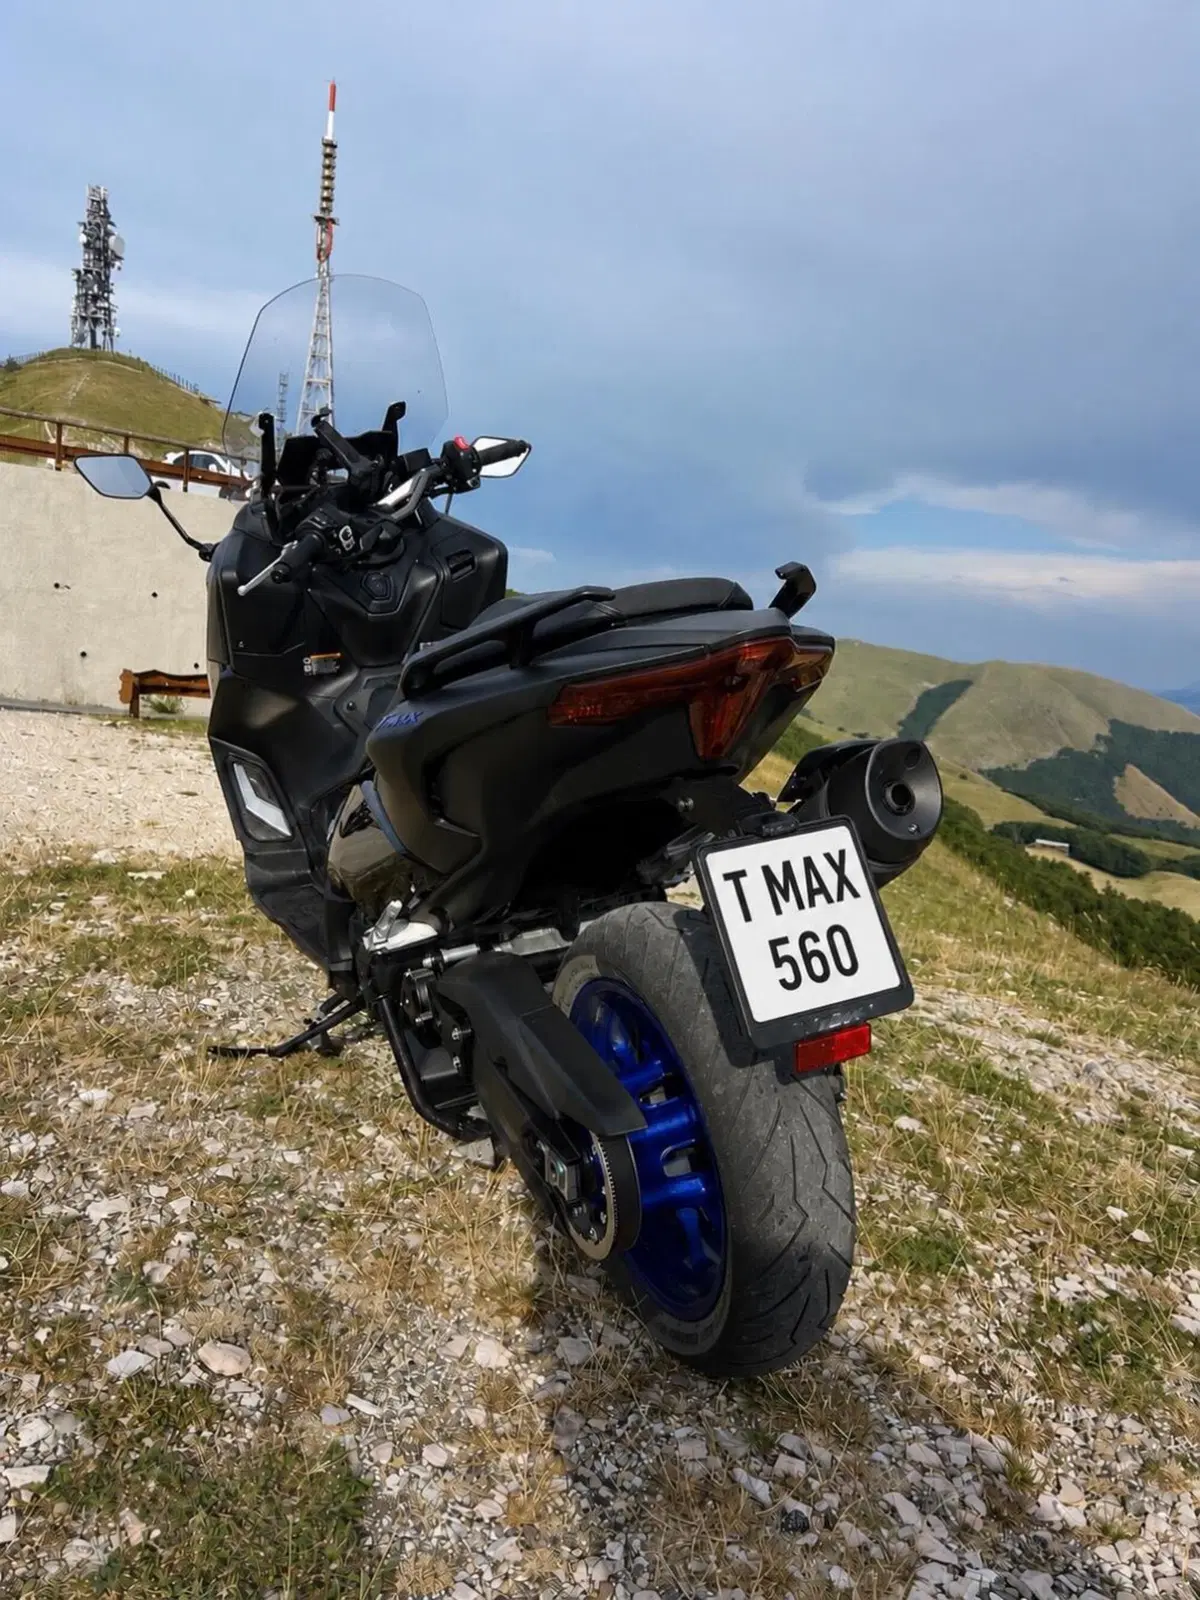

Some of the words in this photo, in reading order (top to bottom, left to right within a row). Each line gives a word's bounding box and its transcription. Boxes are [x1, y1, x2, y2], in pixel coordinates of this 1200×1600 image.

[722, 869, 753, 923] T
[760, 848, 861, 916] MAX
[768, 924, 859, 991] 560
